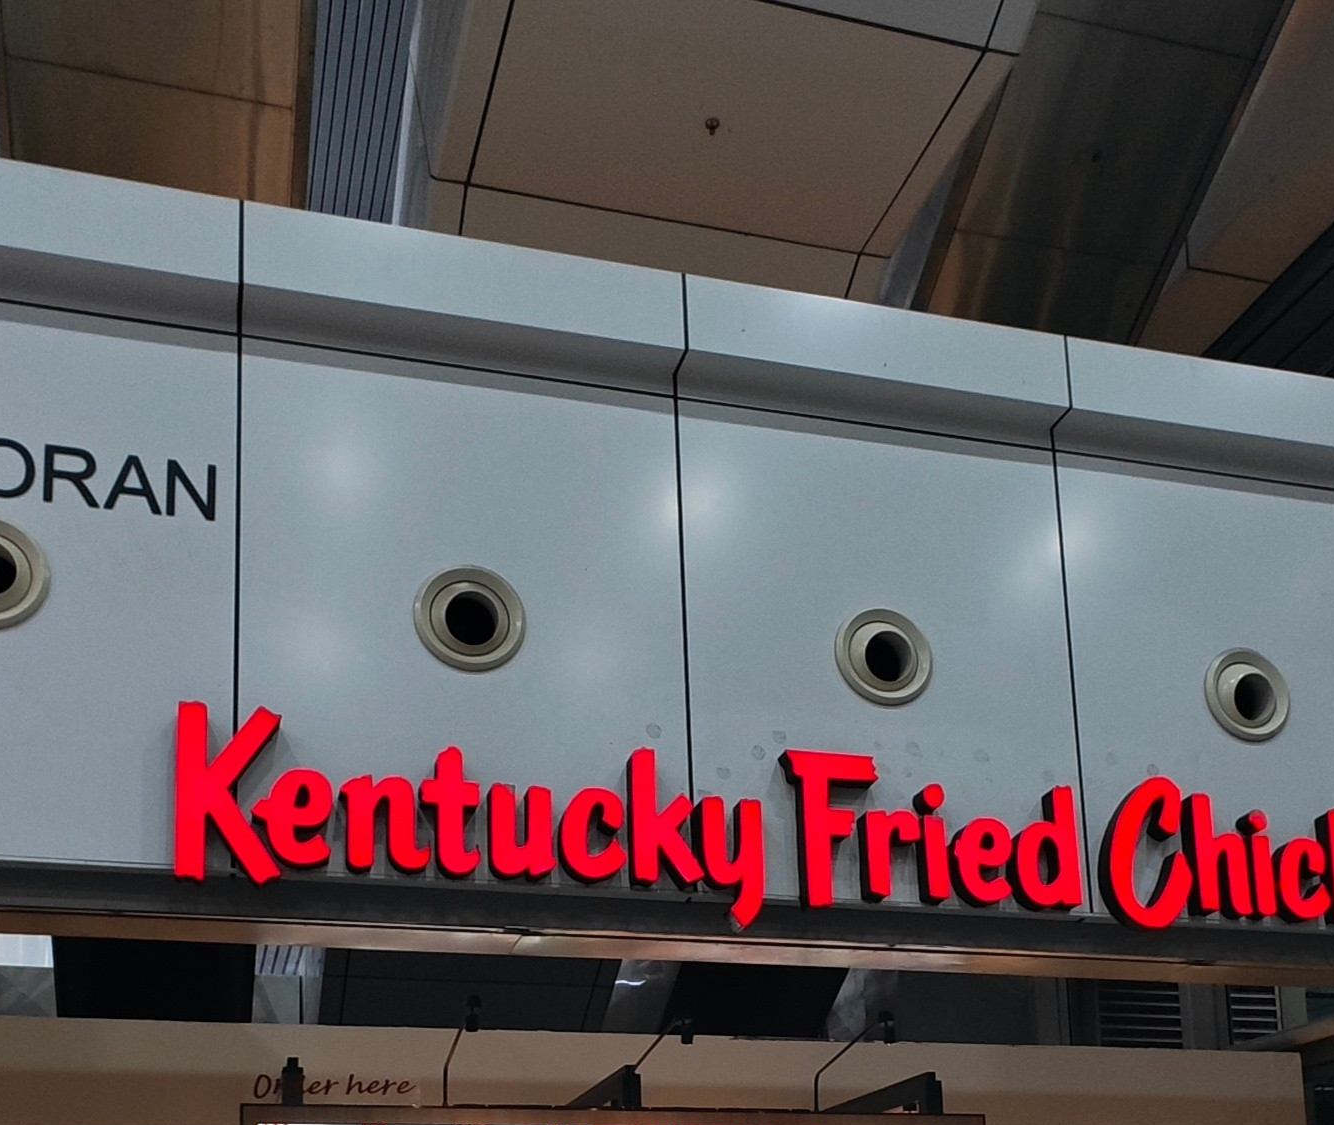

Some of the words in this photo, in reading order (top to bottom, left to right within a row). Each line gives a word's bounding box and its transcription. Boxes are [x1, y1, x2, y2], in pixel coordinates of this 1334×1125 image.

[174, 700, 767, 933] Kentucky
[778, 748, 1083, 909] Fried
[254, 1074, 339, 1099] Orer
[345, 1073, 416, 1095] here
